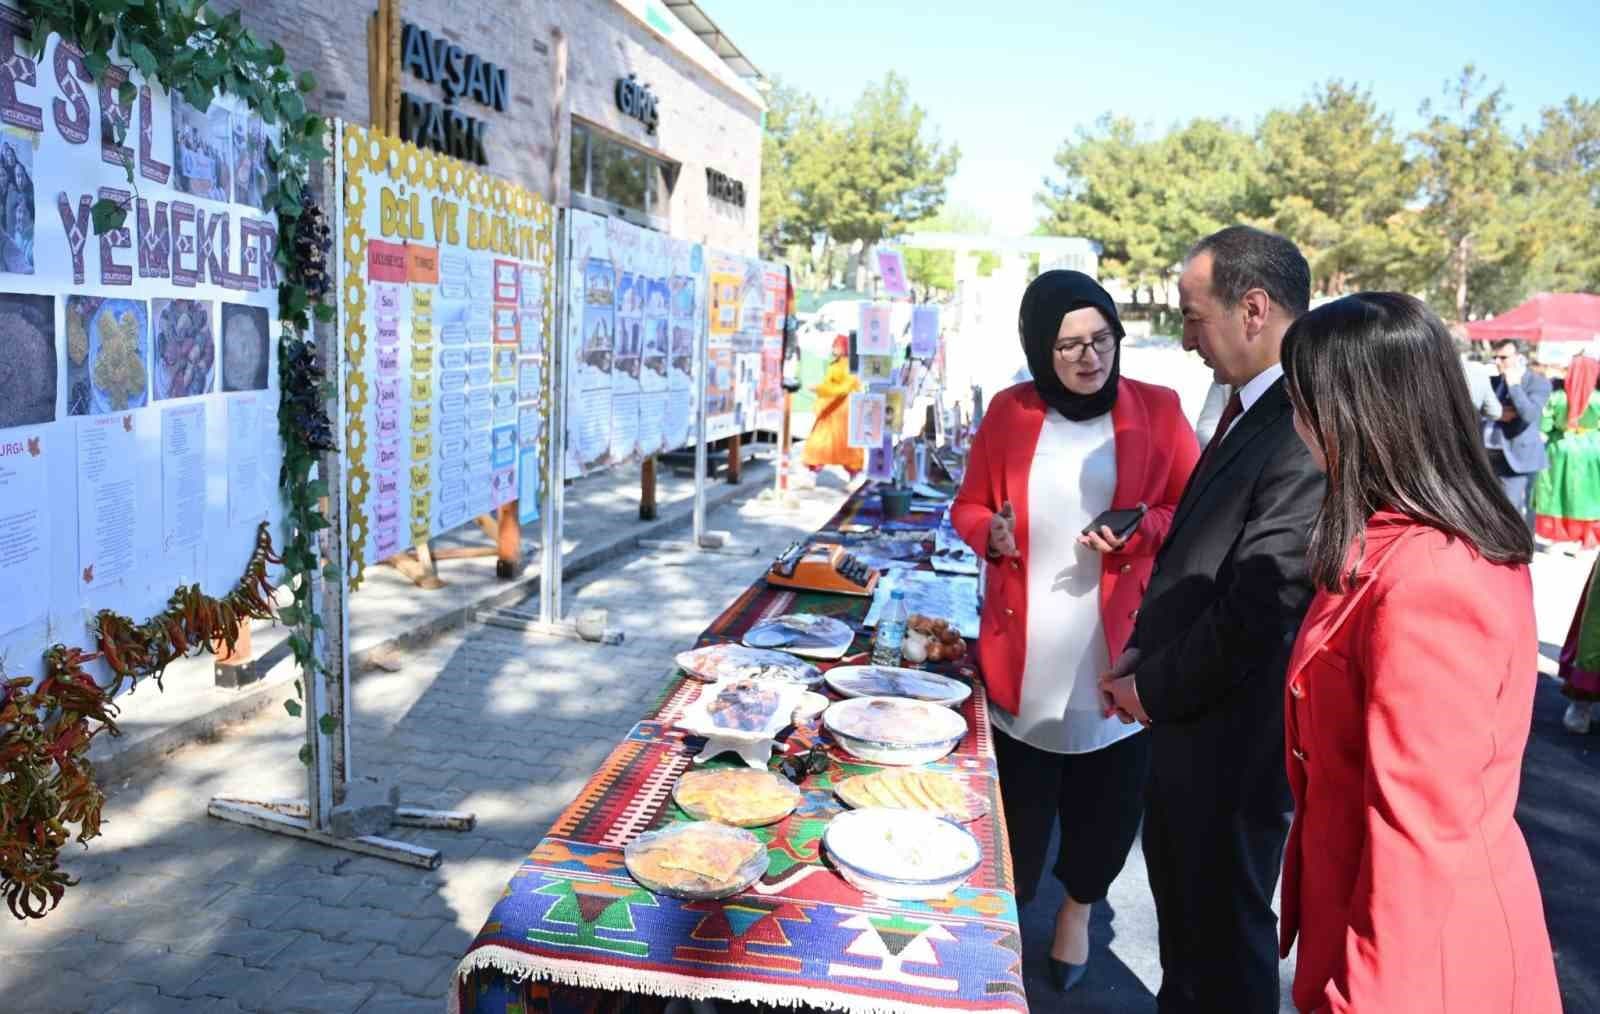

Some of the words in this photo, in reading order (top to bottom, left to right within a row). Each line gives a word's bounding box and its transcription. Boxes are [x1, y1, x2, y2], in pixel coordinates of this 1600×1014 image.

[401, 24, 512, 112] AVŞAN
[400, 93, 497, 165] PARK
[614, 73, 659, 136] GİRİŞ
[57, 187, 278, 292] YEMEKLER
[380, 184, 424, 240] DİL
[431, 196, 460, 246] VE
